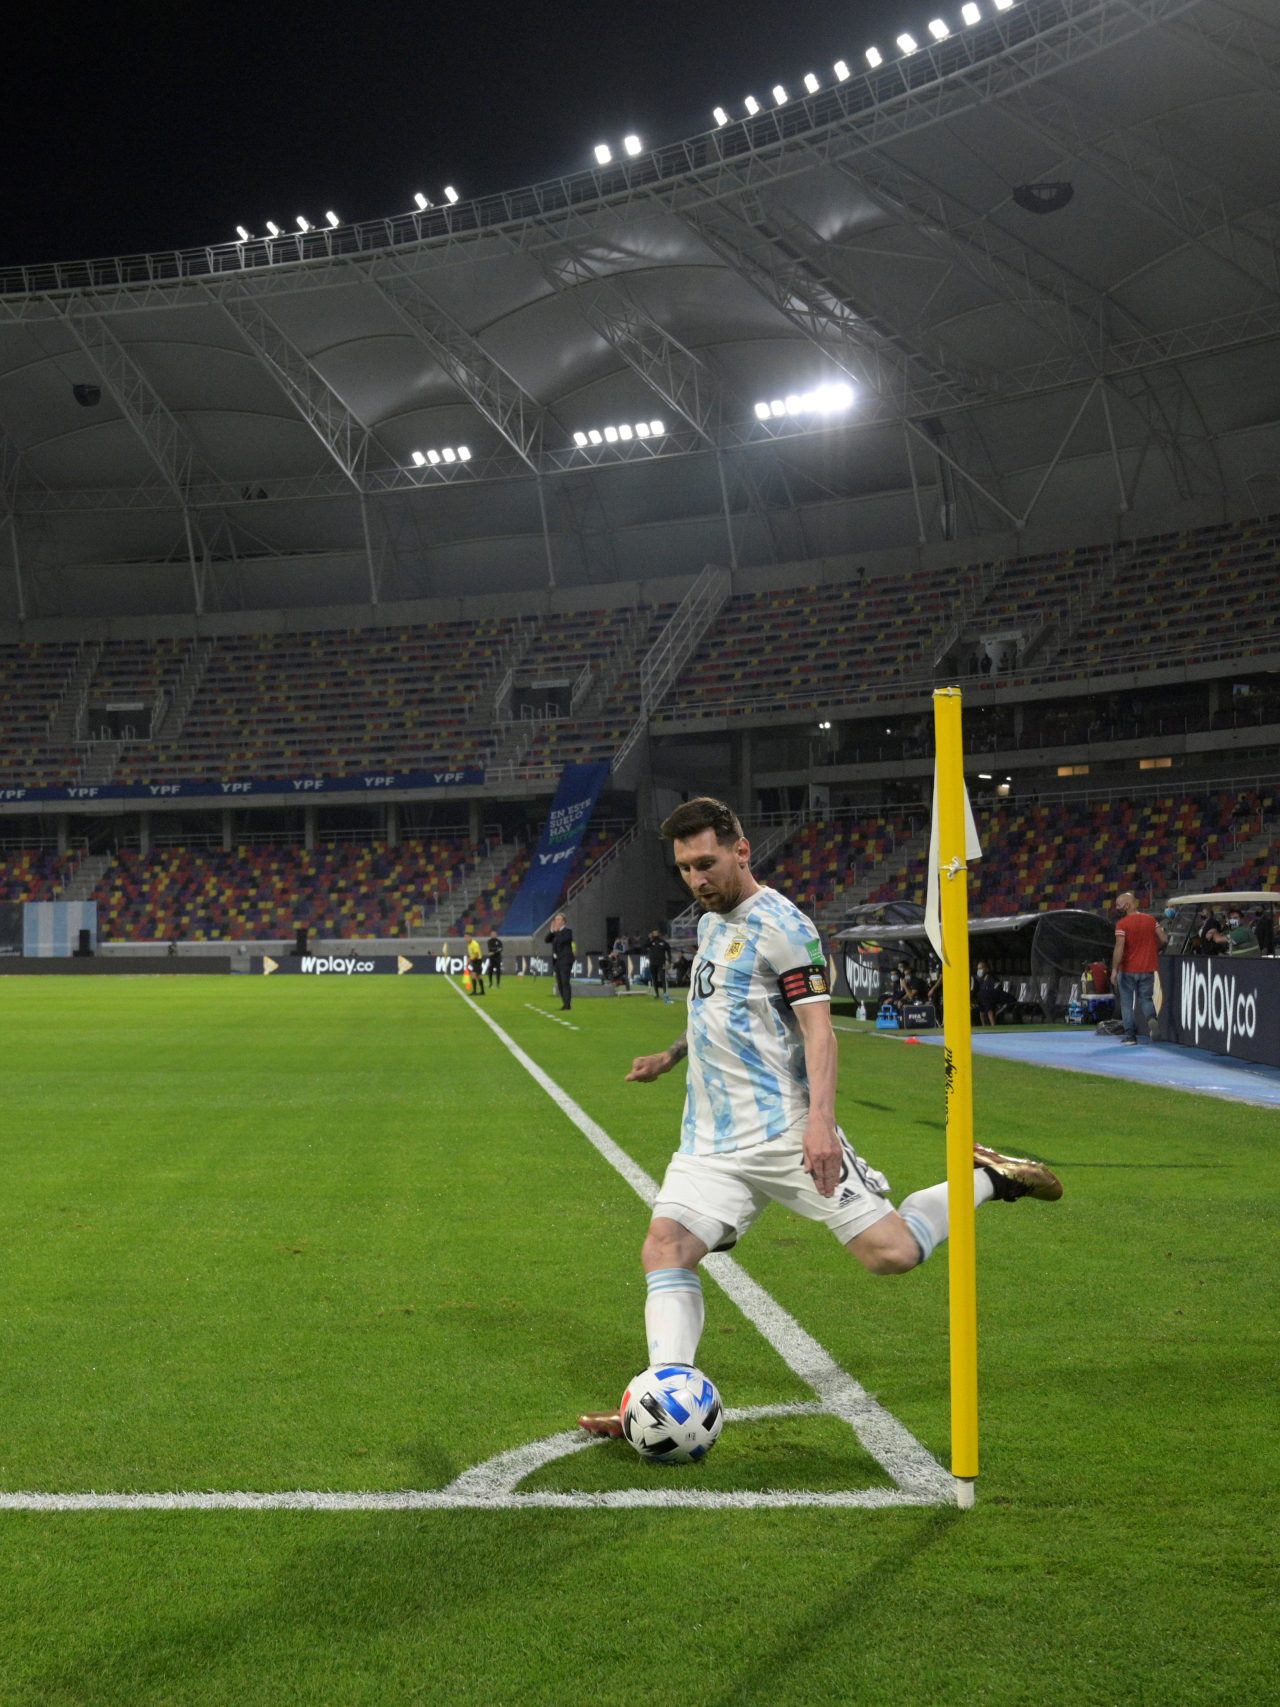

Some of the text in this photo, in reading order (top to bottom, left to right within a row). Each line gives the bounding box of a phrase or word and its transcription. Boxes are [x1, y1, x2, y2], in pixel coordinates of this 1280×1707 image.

[364, 777, 395, 787] YPF
[434, 772, 465, 783] YPF
[149, 785, 181, 795] YPF
[221, 782, 252, 792] YPF
[292, 780, 324, 790] YPF
[67, 788, 99, 798] YPF
[550, 798, 591, 819] EN ESTE
[550, 811, 583, 828] SUELO
[550, 824, 572, 836] HAY
[539, 846, 575, 865] YPF
[301, 956, 374, 975] Wplay.co
[691, 958, 716, 1001] 10
[1181, 958, 1256, 1053] Wplay.co
